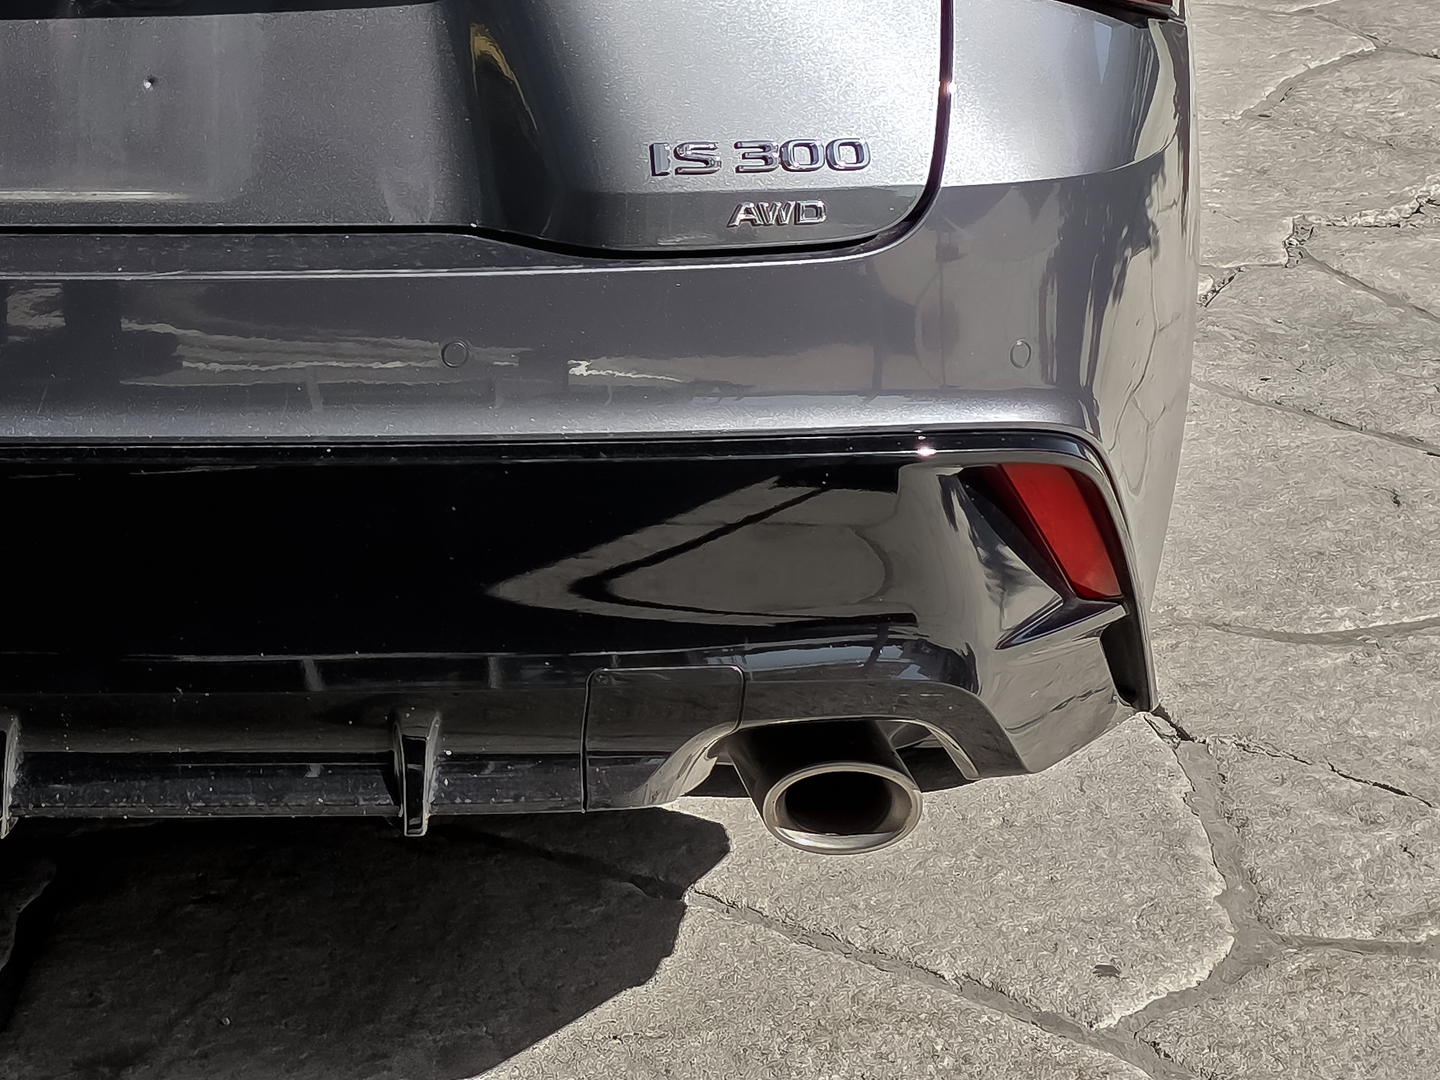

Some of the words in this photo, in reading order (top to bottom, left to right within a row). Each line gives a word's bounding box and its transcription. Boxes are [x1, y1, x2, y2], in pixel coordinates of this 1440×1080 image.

[649, 140, 722, 177] IS
[733, 138, 871, 174] 300
[726, 199, 828, 229] AWD
